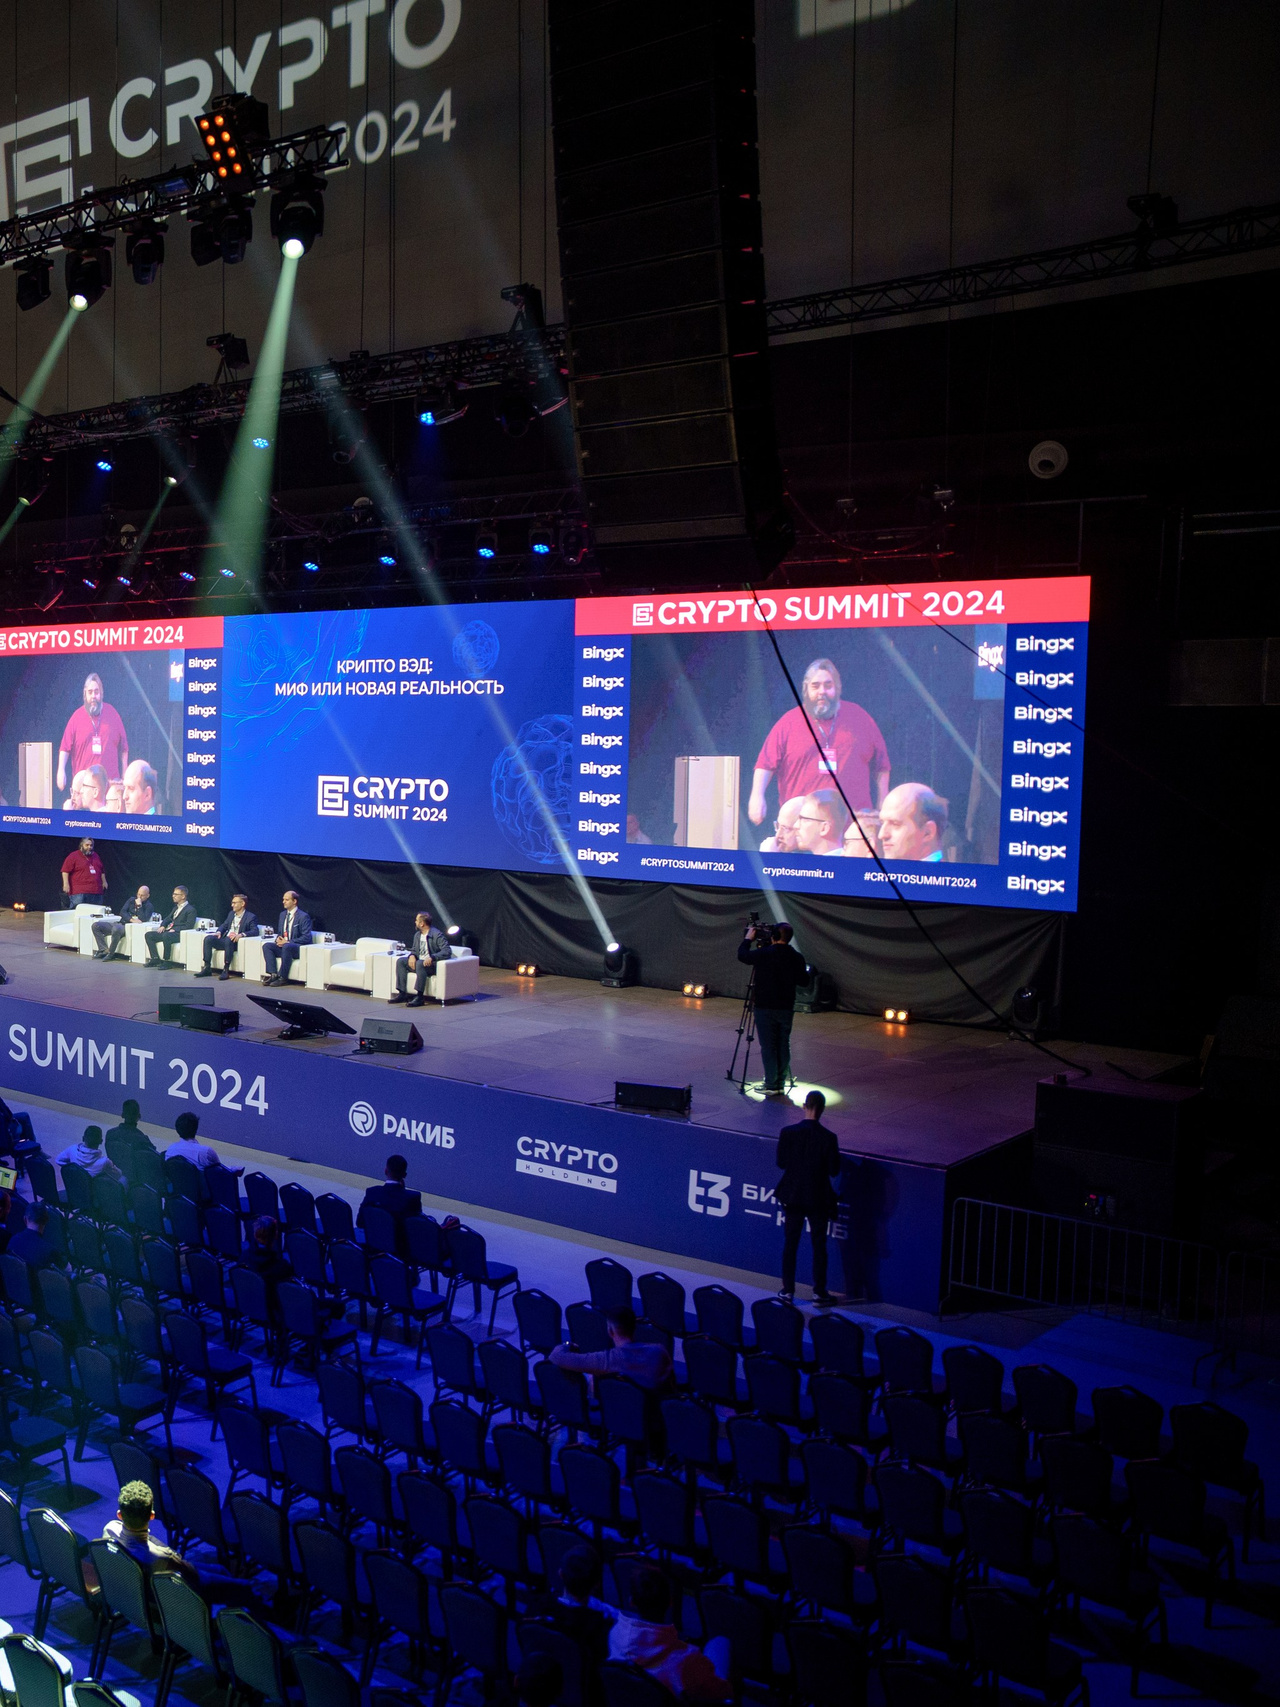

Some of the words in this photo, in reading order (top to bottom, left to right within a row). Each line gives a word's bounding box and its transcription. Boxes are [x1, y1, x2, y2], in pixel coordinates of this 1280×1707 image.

[109, 0, 462, 158] CRYPTO
[658, 597, 778, 626] CRYPTO
[785, 592, 911, 621] SUMMIT
[923, 590, 1005, 616] 2024
[8, 630, 70, 649] CRYPTO
[74, 627, 138, 647] SUMMIT
[143, 626, 184, 644] 2024
[336, 658, 395, 675] КРИПТО
[399, 658, 433, 675] ВЭД:
[275, 682, 309, 698] МИФ
[312, 682, 342, 696] ИЛИ
[345, 681, 397, 696] НОВАЯ
[399, 680, 505, 695] РЕАЛЬНОСТЬ
[353, 776, 449, 802] CRYPTO
[353, 804, 409, 820] SUMMIT
[411, 807, 448, 822] 2024
[640, 857, 735, 872] #CRYPTOSUMMIT2024
[762, 865, 835, 879] cryptosummit.ru
[8, 1023, 155, 1090] SUMMIT
[167, 1057, 269, 1116] 2024
[383, 1114, 455, 1149] РАКИБ
[516, 1136, 619, 1174] CRYPTO
[525, 1163, 607, 1188] HOLDING
